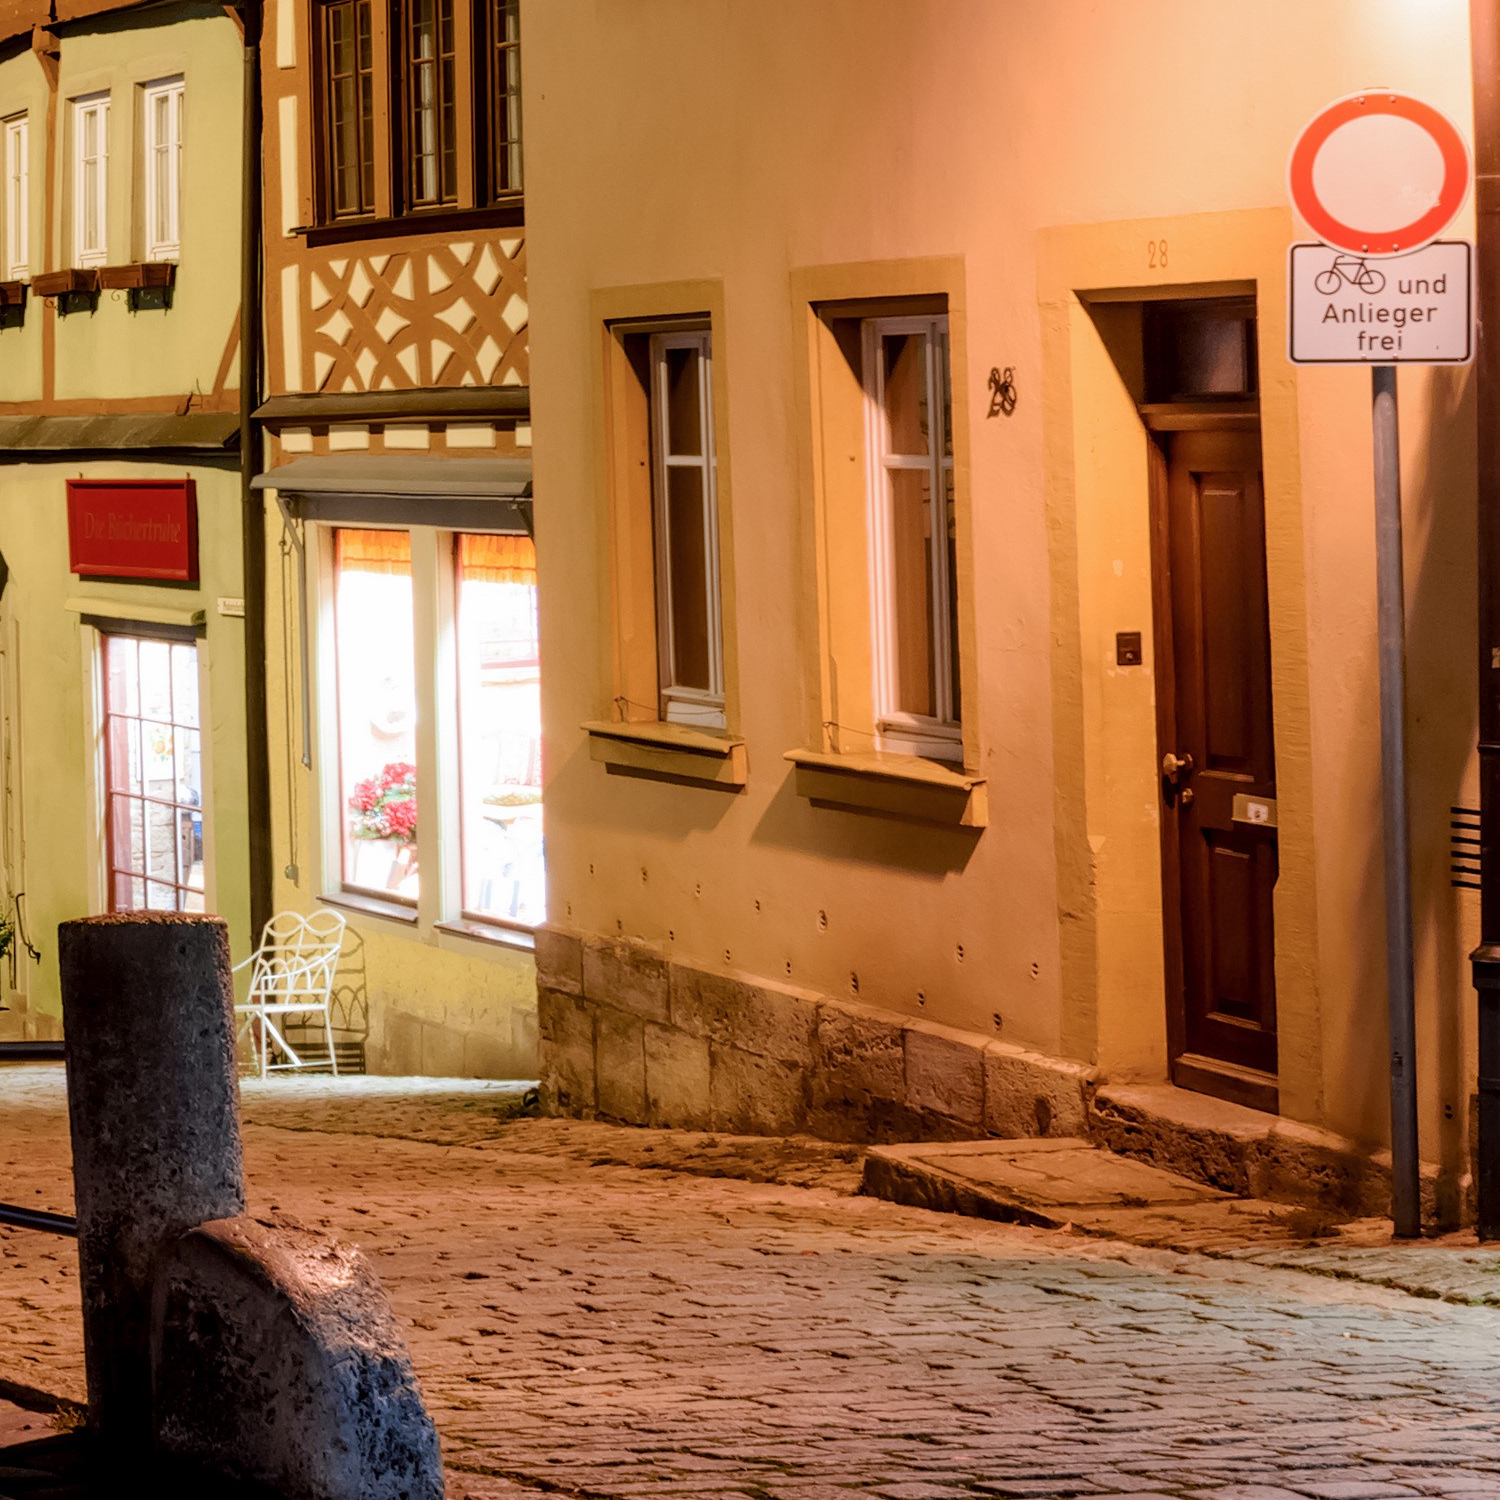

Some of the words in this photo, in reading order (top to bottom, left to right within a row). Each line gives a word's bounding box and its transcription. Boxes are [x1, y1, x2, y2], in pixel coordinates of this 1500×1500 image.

[1148, 239, 1169, 269] 28
[1398, 273, 1447, 295] und
[1321, 302, 1439, 329] Anlieger
[1357, 330, 1403, 352] frei
